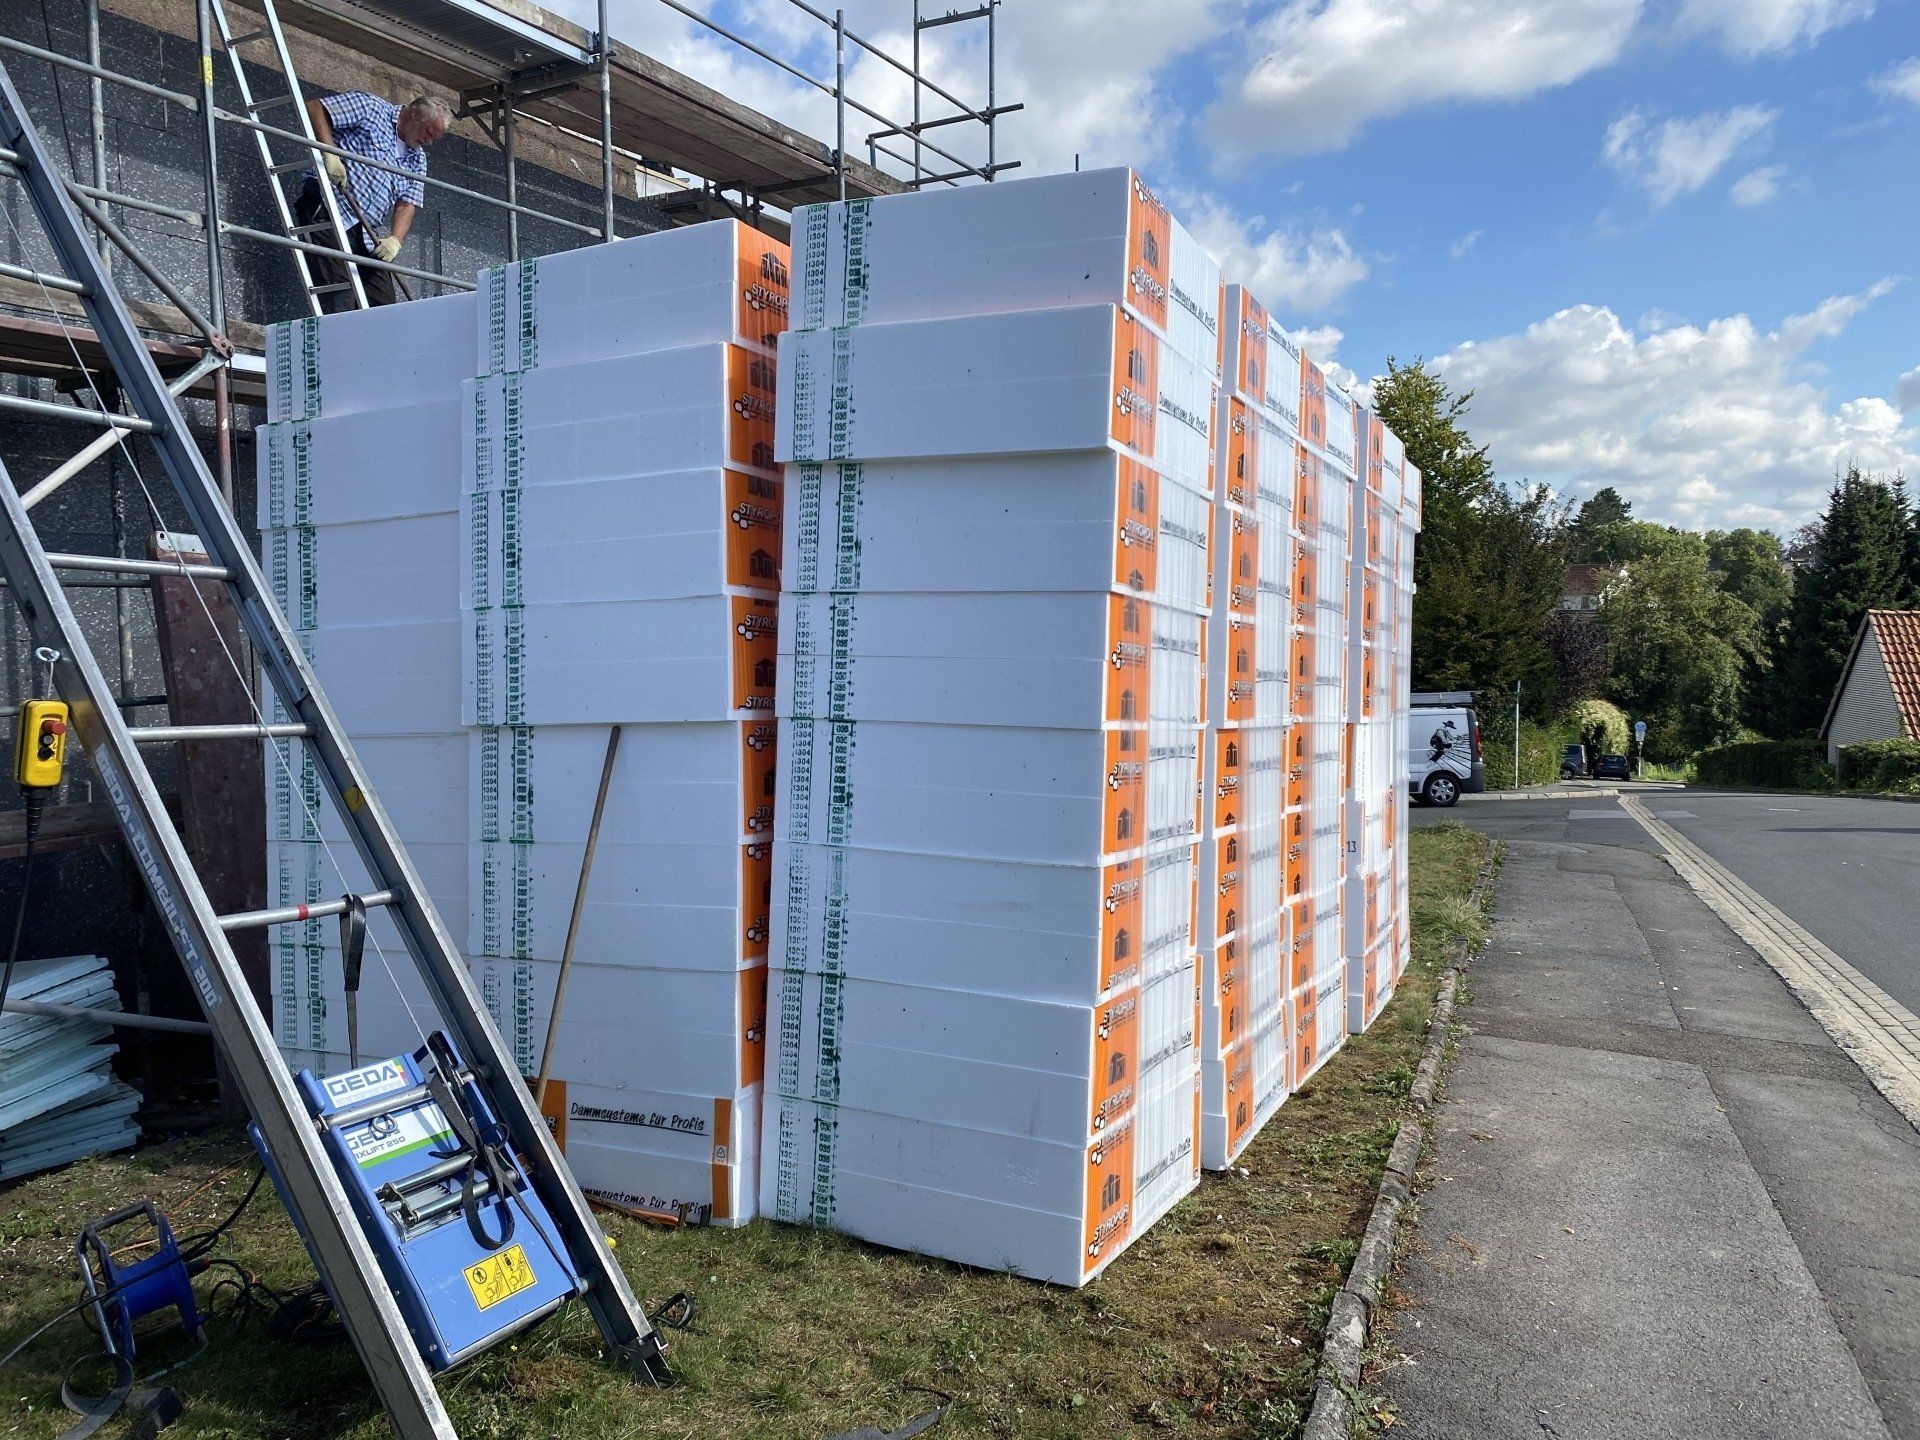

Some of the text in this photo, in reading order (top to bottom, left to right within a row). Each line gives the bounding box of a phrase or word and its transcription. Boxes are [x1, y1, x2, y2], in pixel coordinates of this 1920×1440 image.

[810, 213, 826, 221] 1304
[809, 223, 826, 231] 1304
[809, 232, 825, 240] 1304
[809, 242, 825, 250] 1304
[808, 251, 824, 259] 1304
[807, 269, 824, 277] 1304
[752, 283, 788, 309] STYROP
[742, 393, 776, 414] STYRO
[745, 614, 776, 629] STYRO
[794, 766, 810, 774] 1304
[1347, 841, 1357, 853] 13
[785, 976, 801, 985] 1304
[193, 965, 219, 1009] 200
[785, 985, 800, 993] 1304
[784, 995, 800, 1003] 1304
[784, 1004, 800, 1012] 1304
[783, 1013, 799, 1021] 1304
[783, 1022, 799, 1030] 1304
[782, 1031, 798, 1040] 1304
[782, 1040, 798, 1049] 1304
[781, 1068, 796, 1076] 1304
[327, 1064, 399, 1097] GEDA
[649, 1108, 667, 1127] für
[671, 1117, 705, 1131] Profis
[354, 1136, 406, 1160] IXLIFT 250
[1094, 1204, 1129, 1241] STYROPOR
